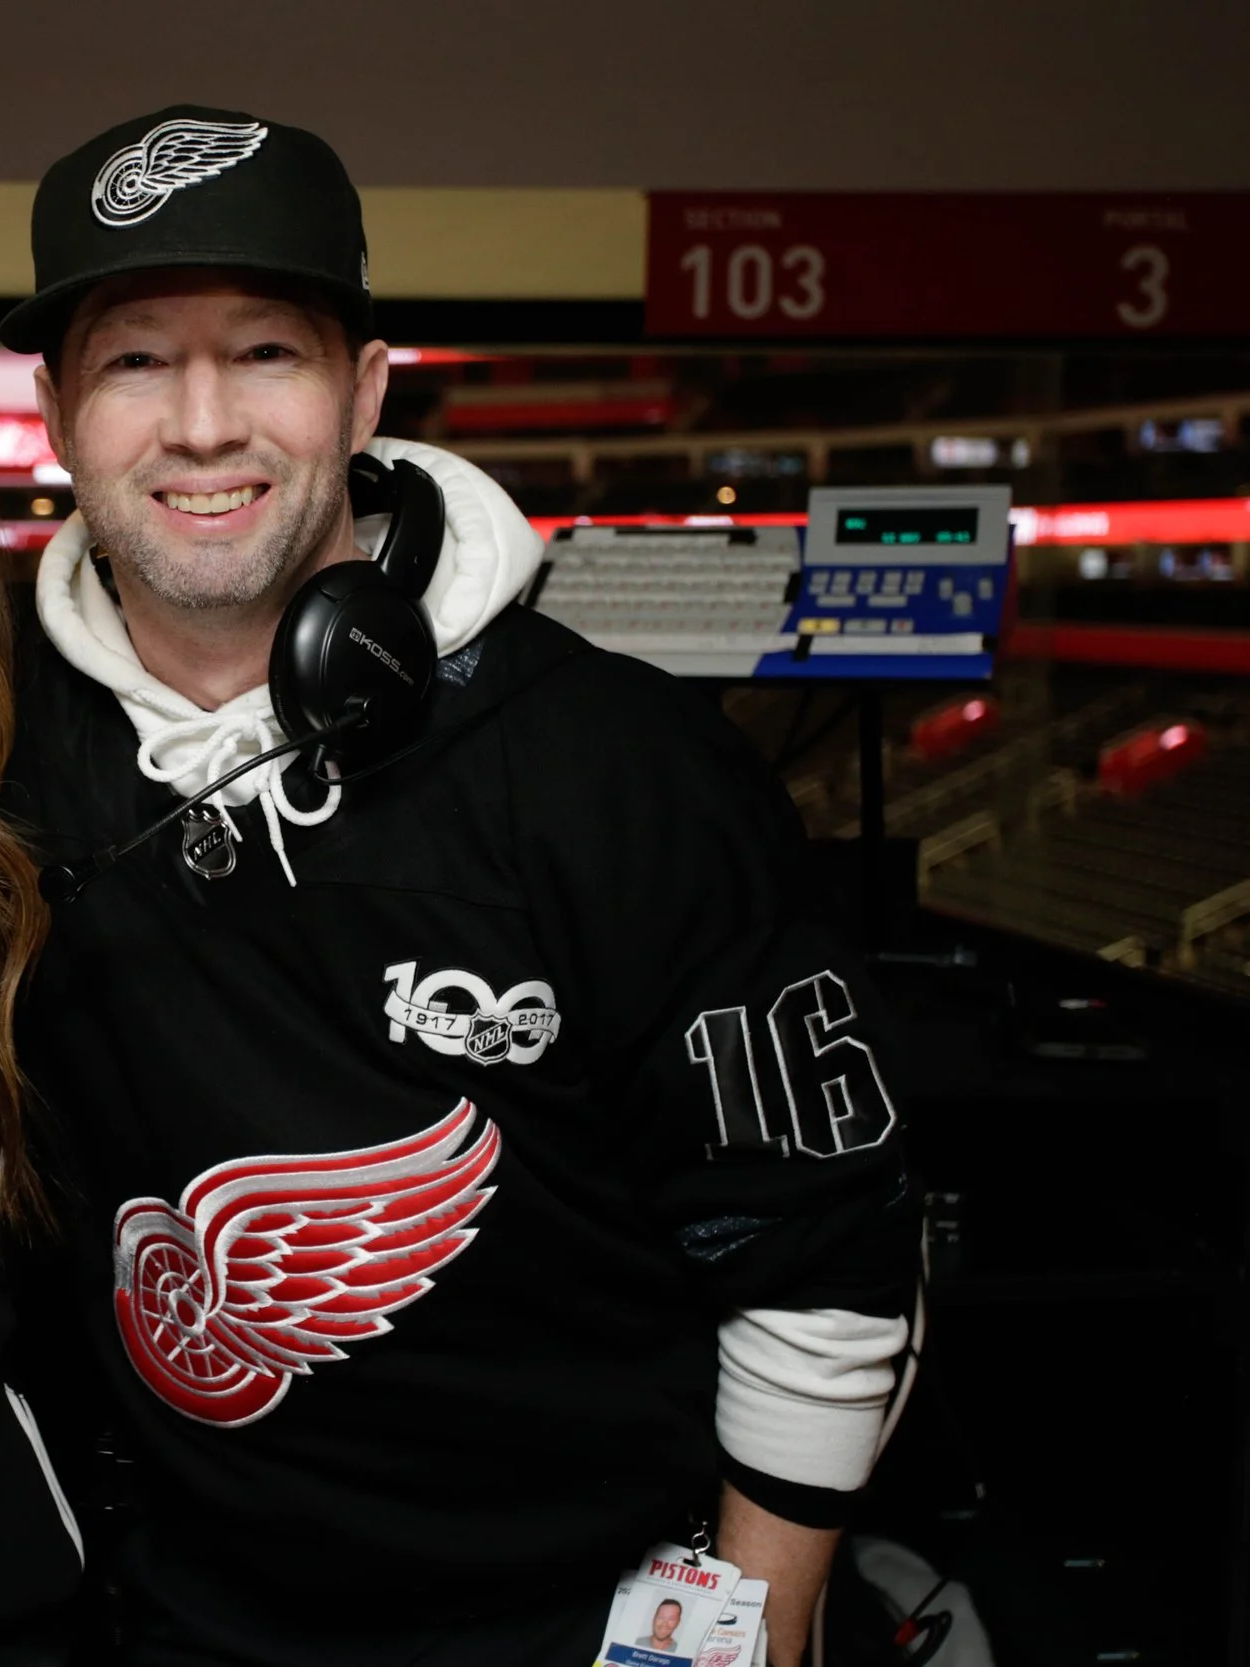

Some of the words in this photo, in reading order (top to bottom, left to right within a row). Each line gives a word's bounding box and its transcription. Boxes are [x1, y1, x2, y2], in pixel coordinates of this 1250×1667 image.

[680, 244, 825, 320] 103
[1116, 244, 1169, 328] 3
[194, 832, 221, 861] NHL
[403, 1008, 457, 1031] 1917
[518, 1012, 554, 1026] 2017
[474, 1026, 506, 1052] NHL
[685, 969, 897, 1161] 16
[649, 1559, 721, 1590] PISTONS
[730, 1598, 762, 1608] Season
